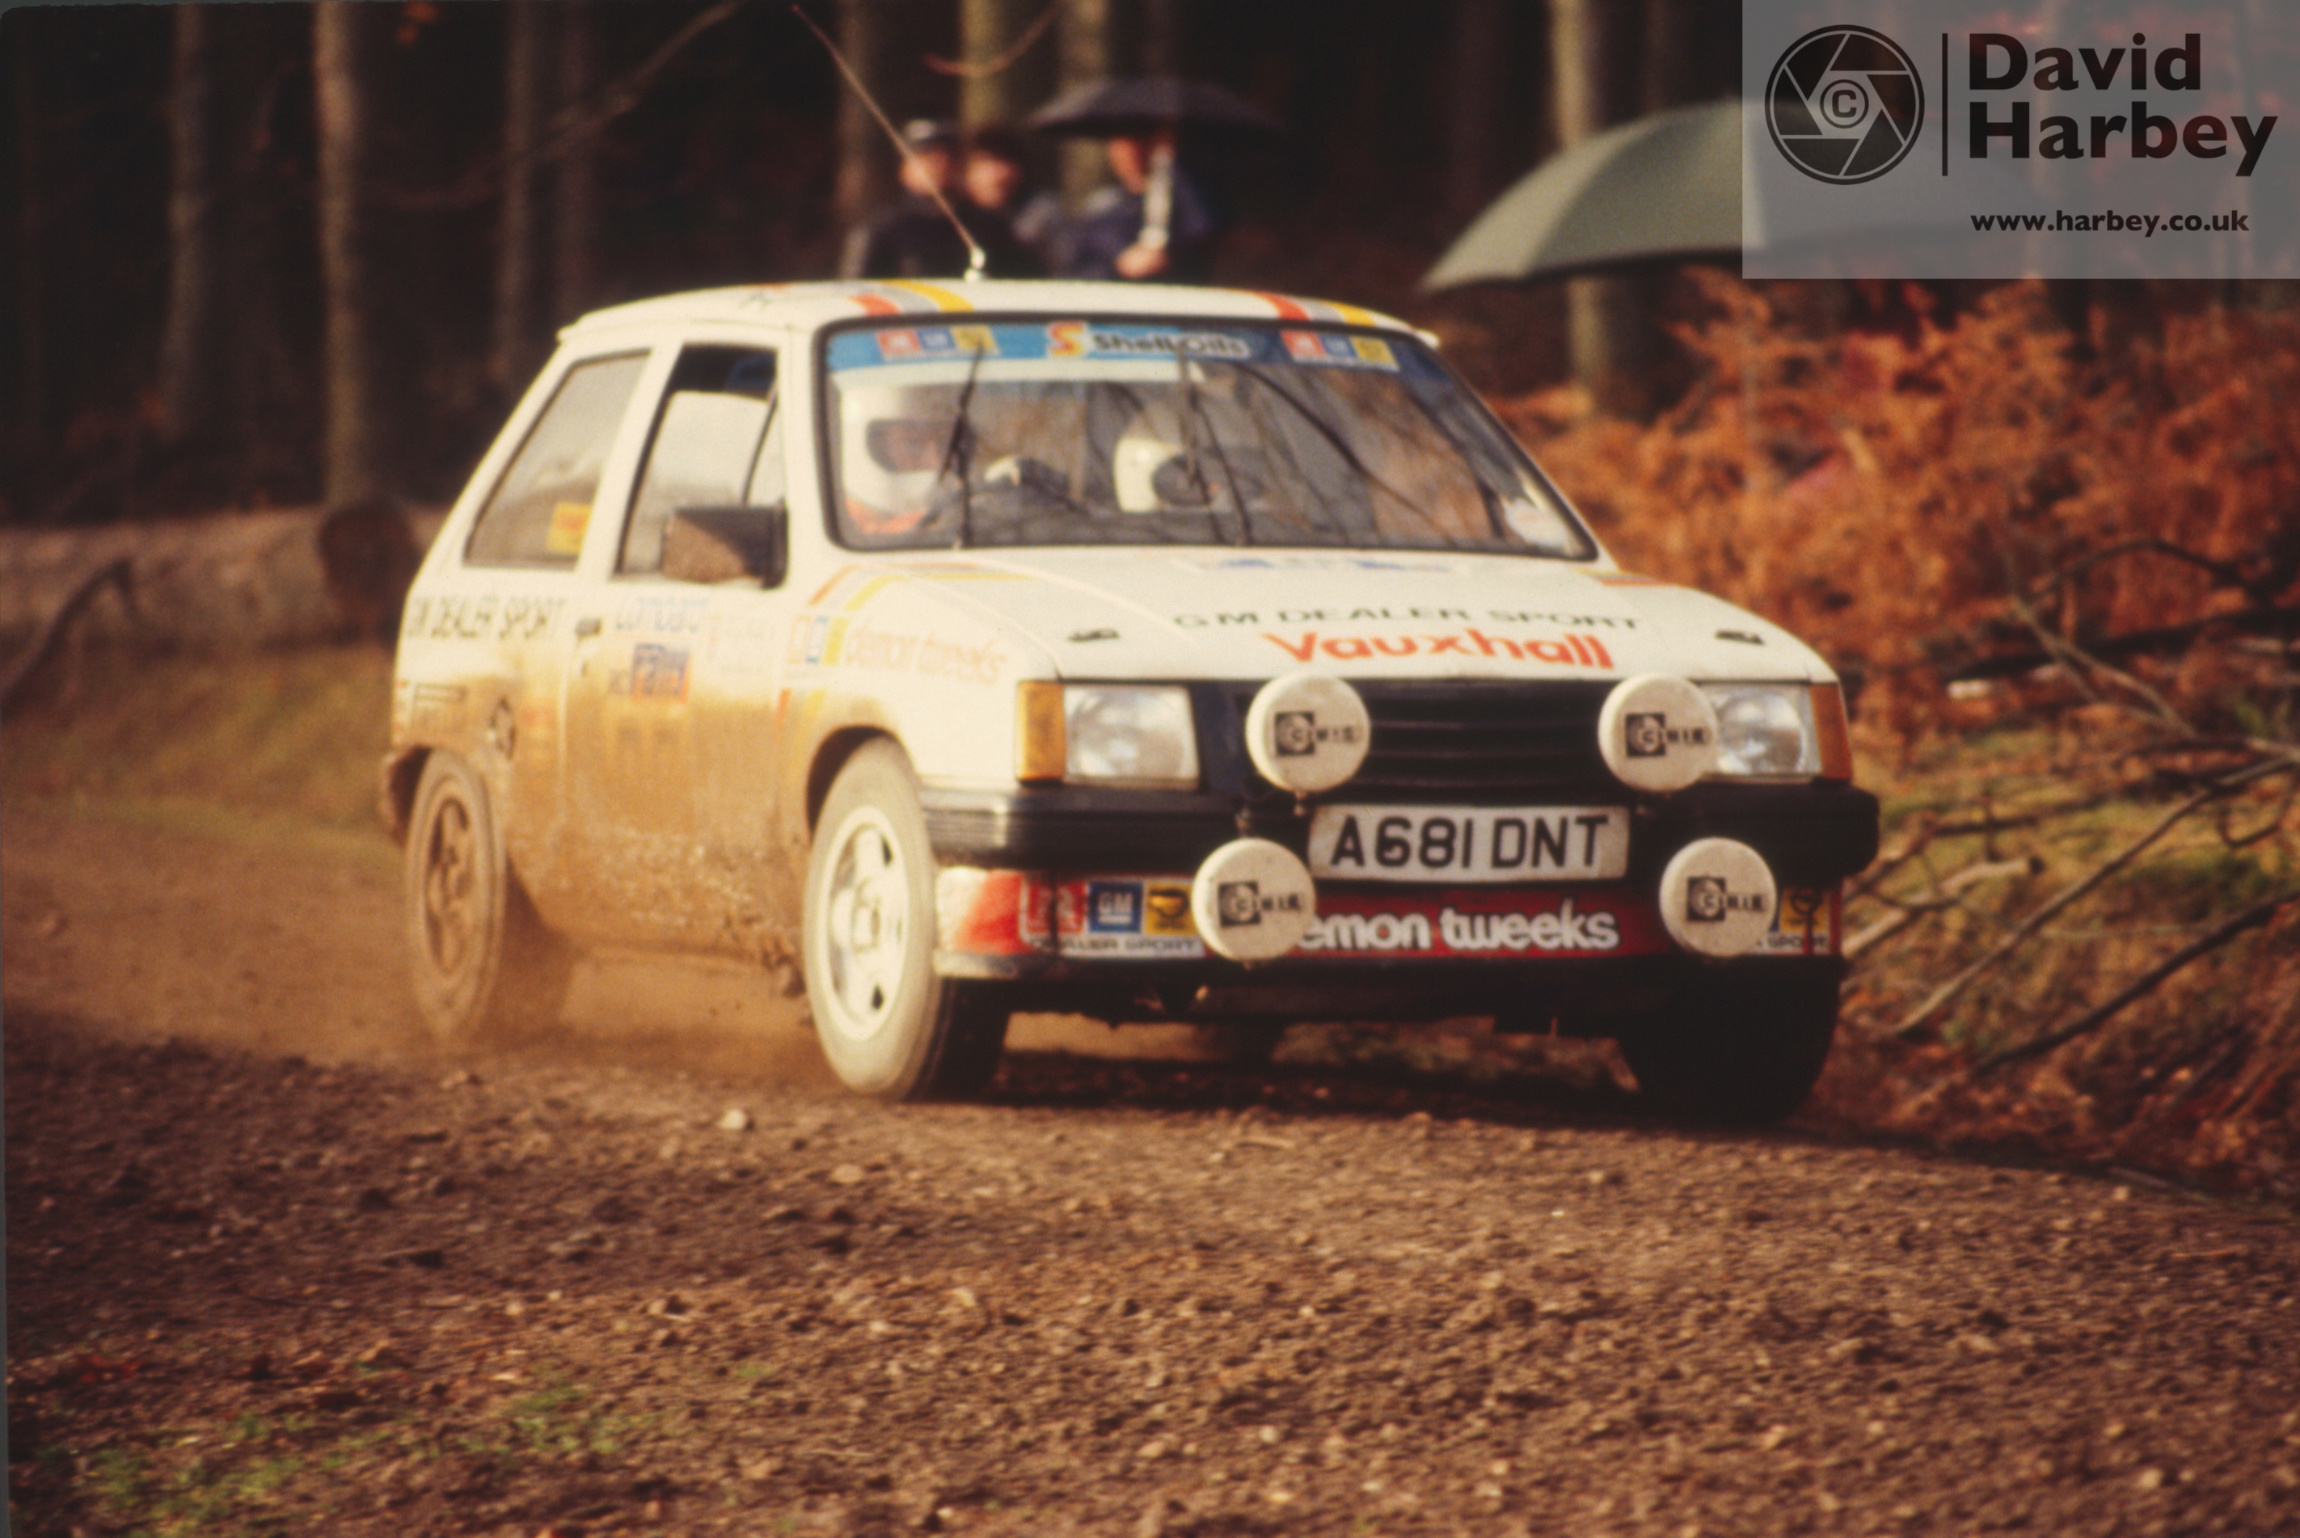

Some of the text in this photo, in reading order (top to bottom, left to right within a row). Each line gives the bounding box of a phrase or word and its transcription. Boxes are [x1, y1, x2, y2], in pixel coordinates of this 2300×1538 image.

[1173, 606, 1642, 630] GM DEALER SPORT
[1259, 629, 1614, 670] Vauxhall
[1331, 814, 1609, 868] A681 DNT
[1097, 892, 1134, 914] GM
[1302, 899, 1620, 951] emon tweeks
